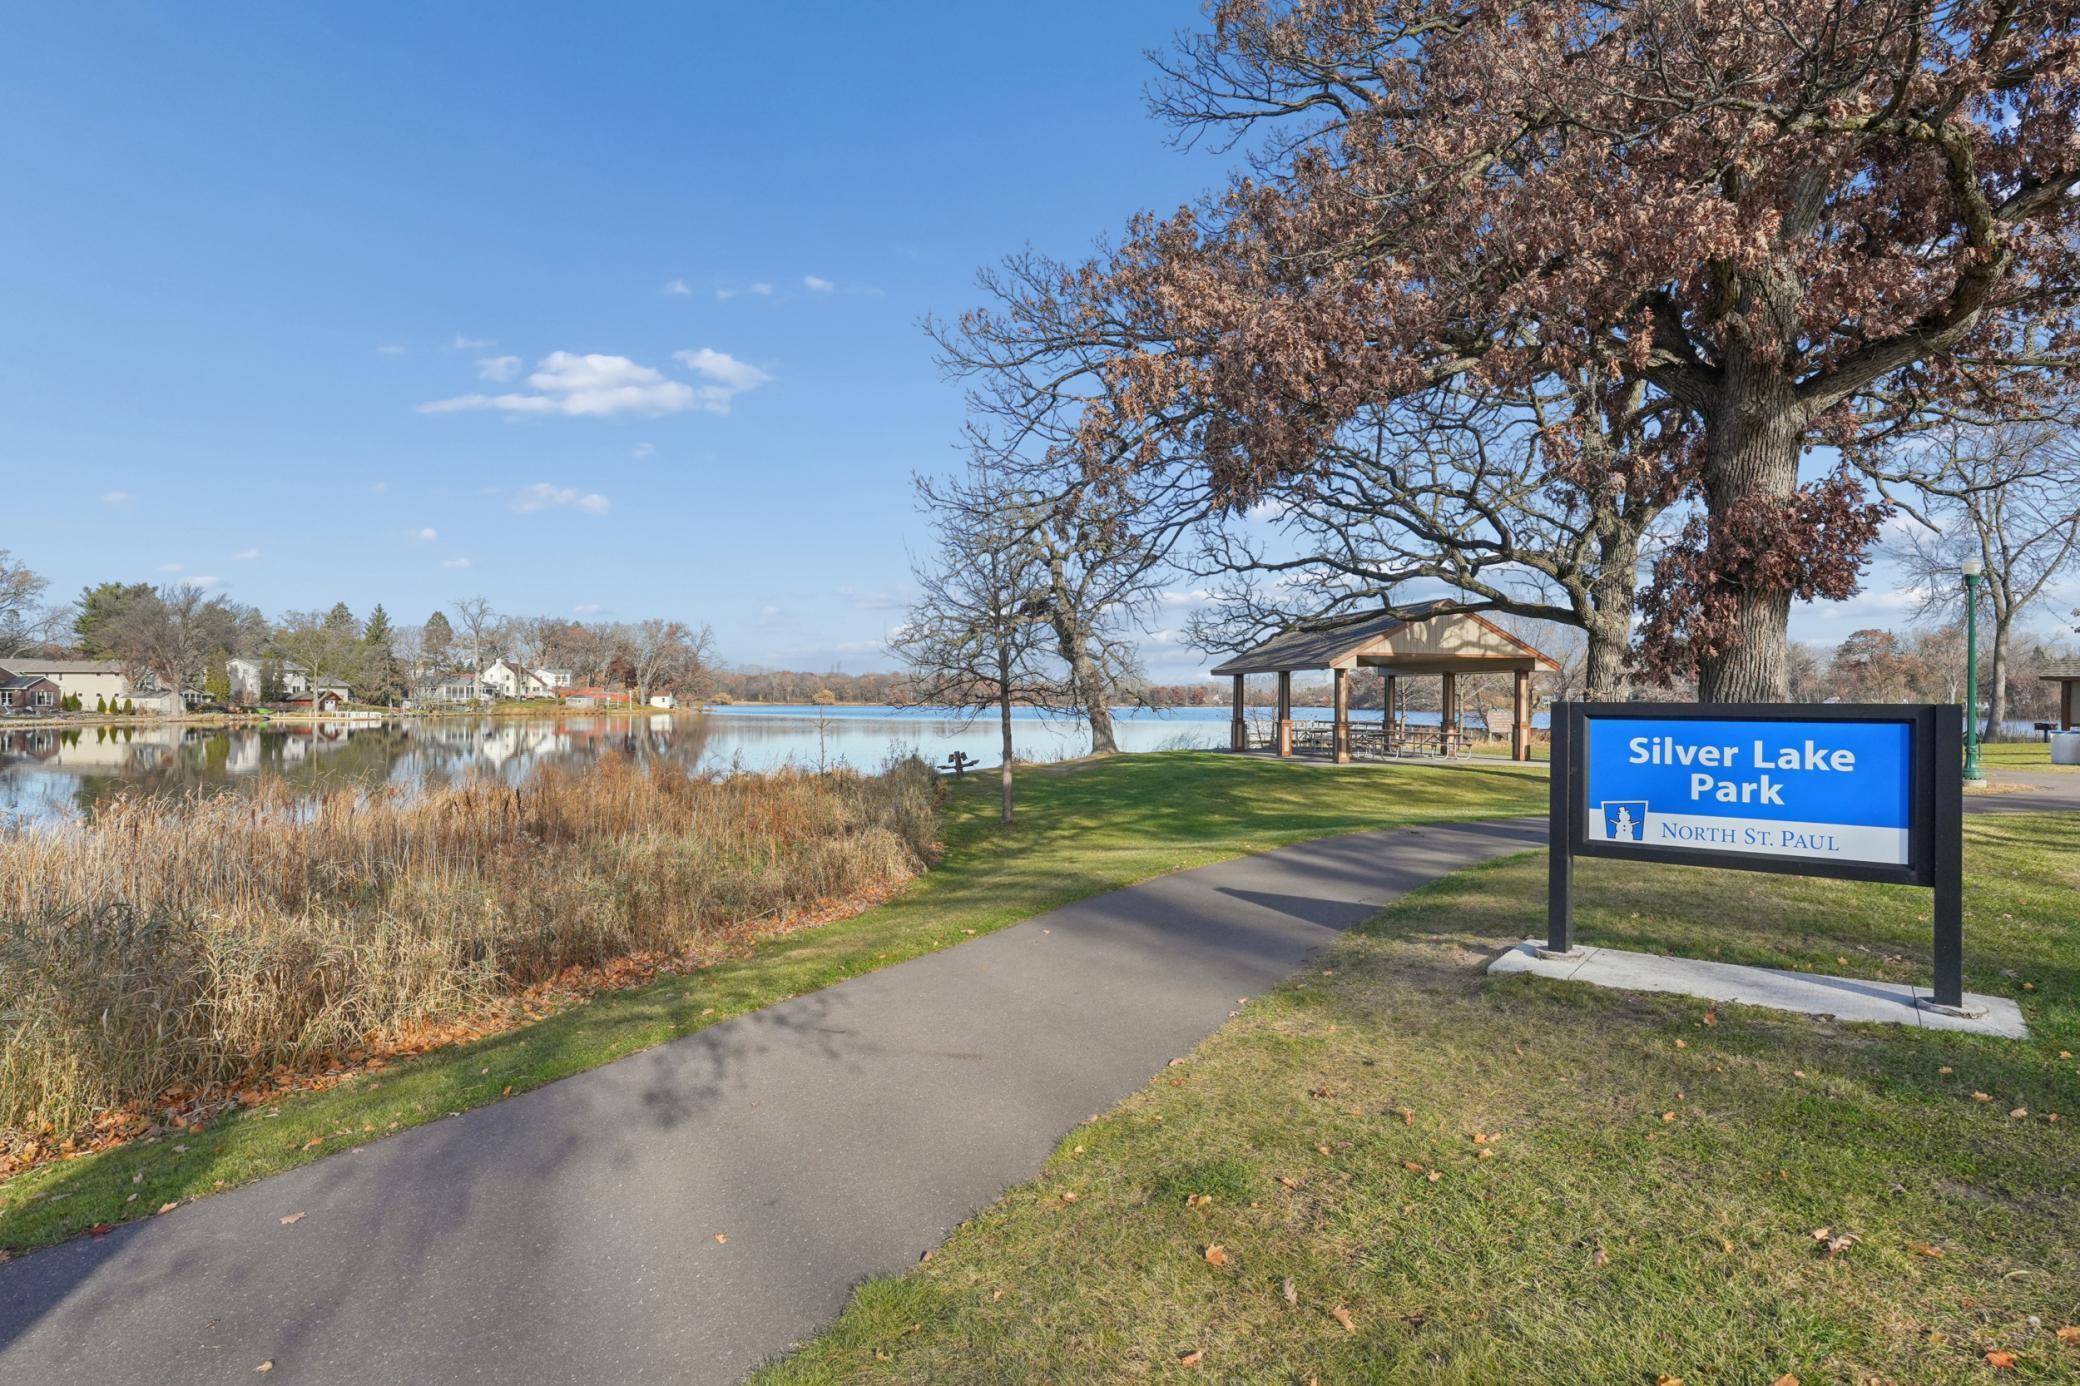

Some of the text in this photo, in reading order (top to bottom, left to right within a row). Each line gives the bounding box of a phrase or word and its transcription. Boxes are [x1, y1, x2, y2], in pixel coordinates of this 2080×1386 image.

[1629, 736, 1856, 772] Silver Lake
[1691, 773, 1785, 805] Park
[1661, 821, 1840, 852] NORTH ST. PAUL
